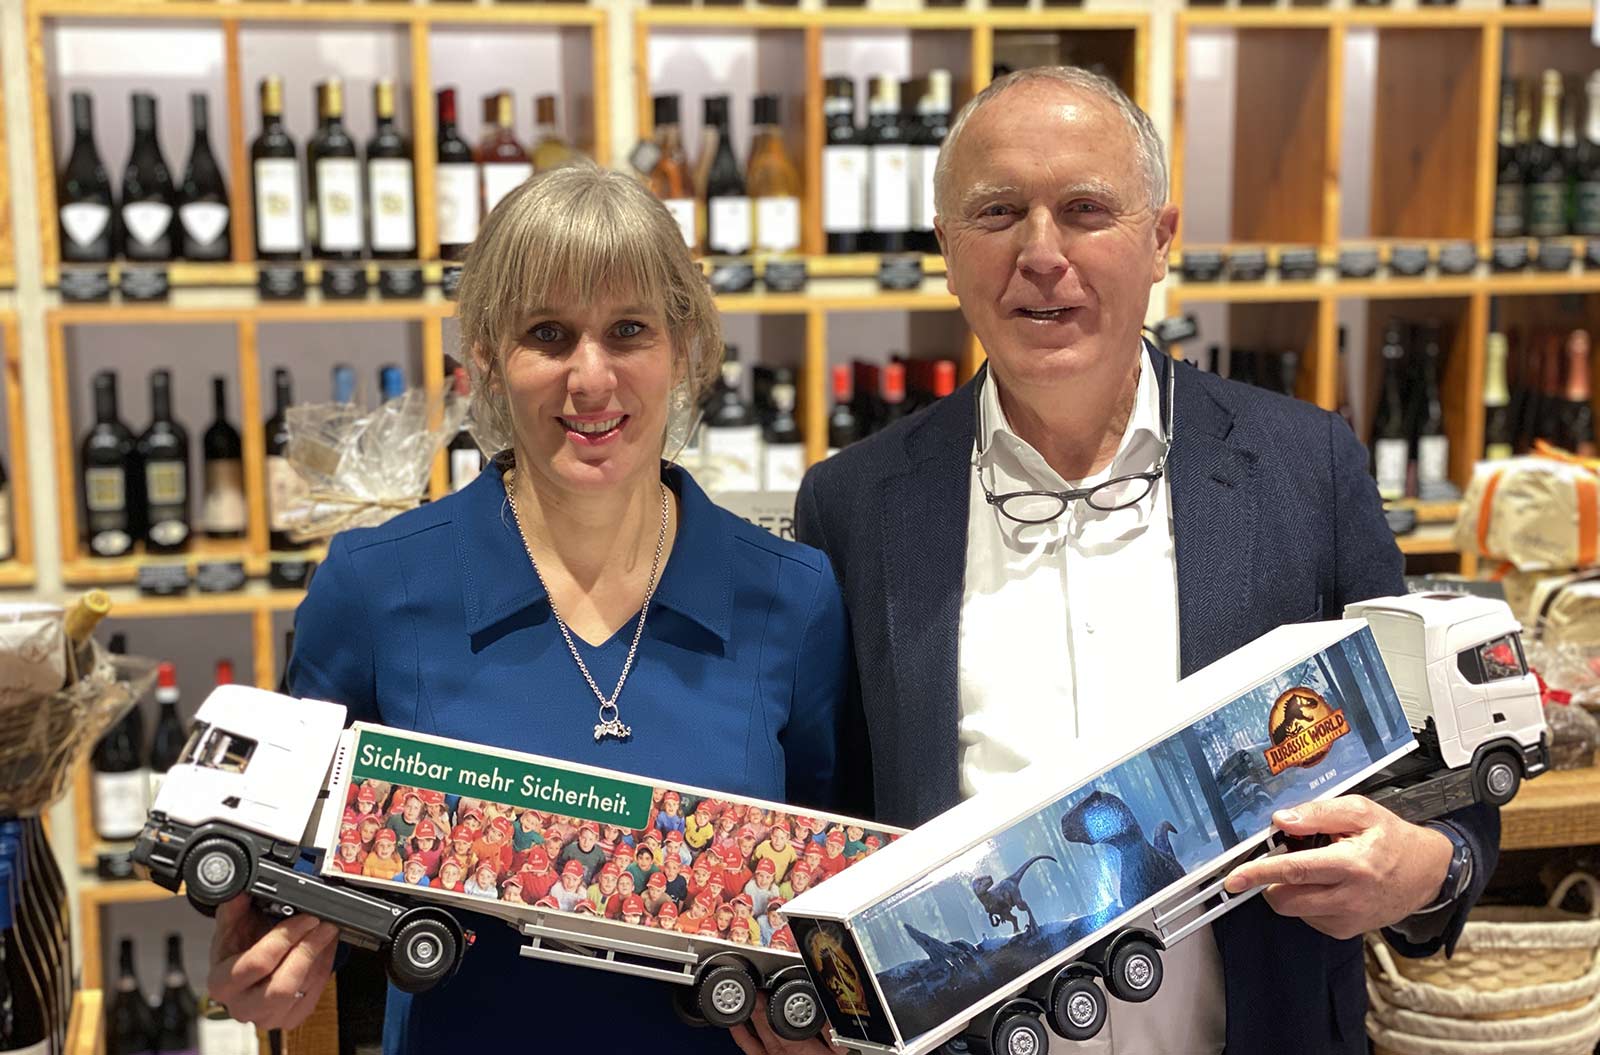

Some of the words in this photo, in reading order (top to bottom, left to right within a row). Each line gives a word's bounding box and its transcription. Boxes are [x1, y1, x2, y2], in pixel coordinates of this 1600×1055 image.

[1269, 734, 1309, 767] JURASSIC
[1307, 714, 1345, 743] WORLD
[360, 743, 453, 781] Sichtbar
[458, 767, 515, 793] mehr
[520, 774, 631, 817] Sicherheit.
